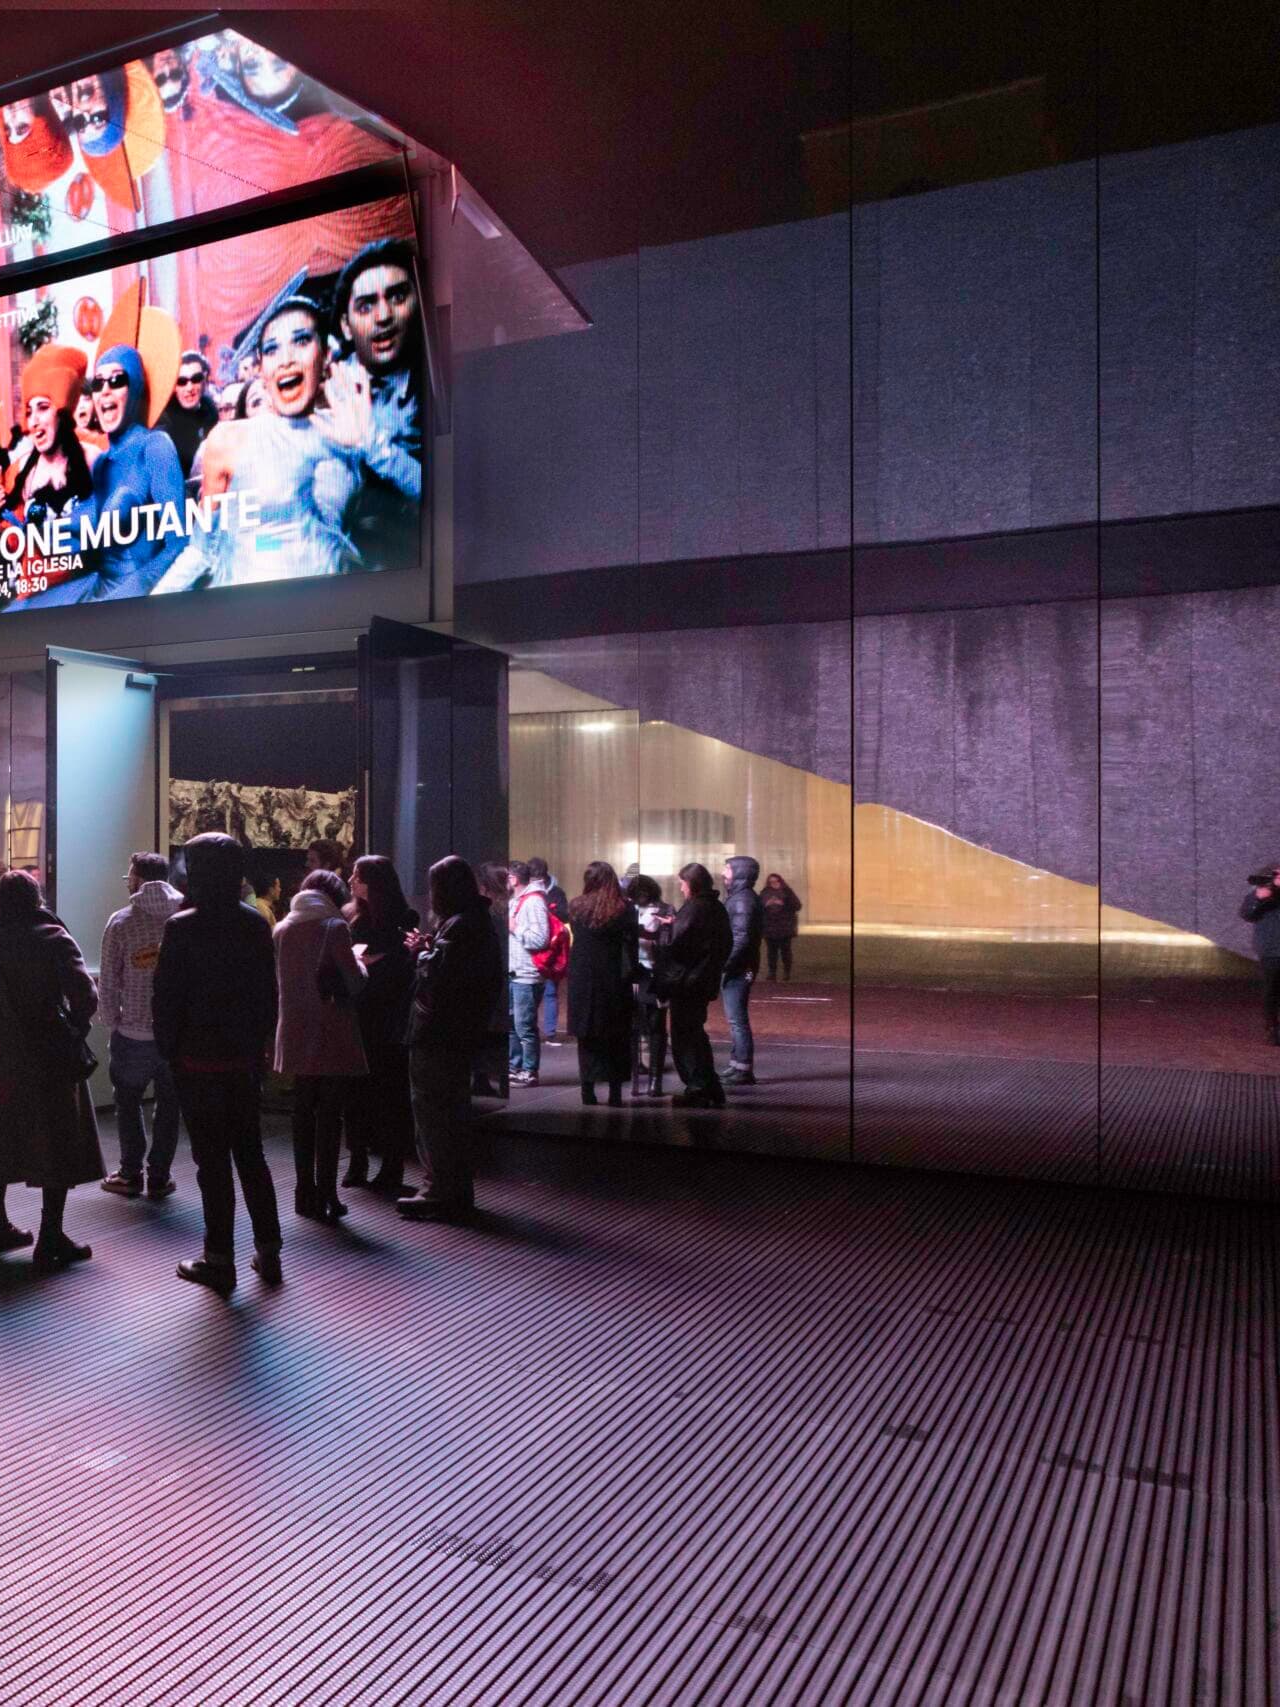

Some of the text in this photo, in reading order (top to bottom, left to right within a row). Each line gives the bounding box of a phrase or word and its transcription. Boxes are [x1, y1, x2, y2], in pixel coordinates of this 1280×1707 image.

[80, 489, 261, 551] MUTANTE
[7, 561, 24, 579] LA
[27, 554, 84, 576] IGLESIA
[15, 577, 48, 595] 18:30
